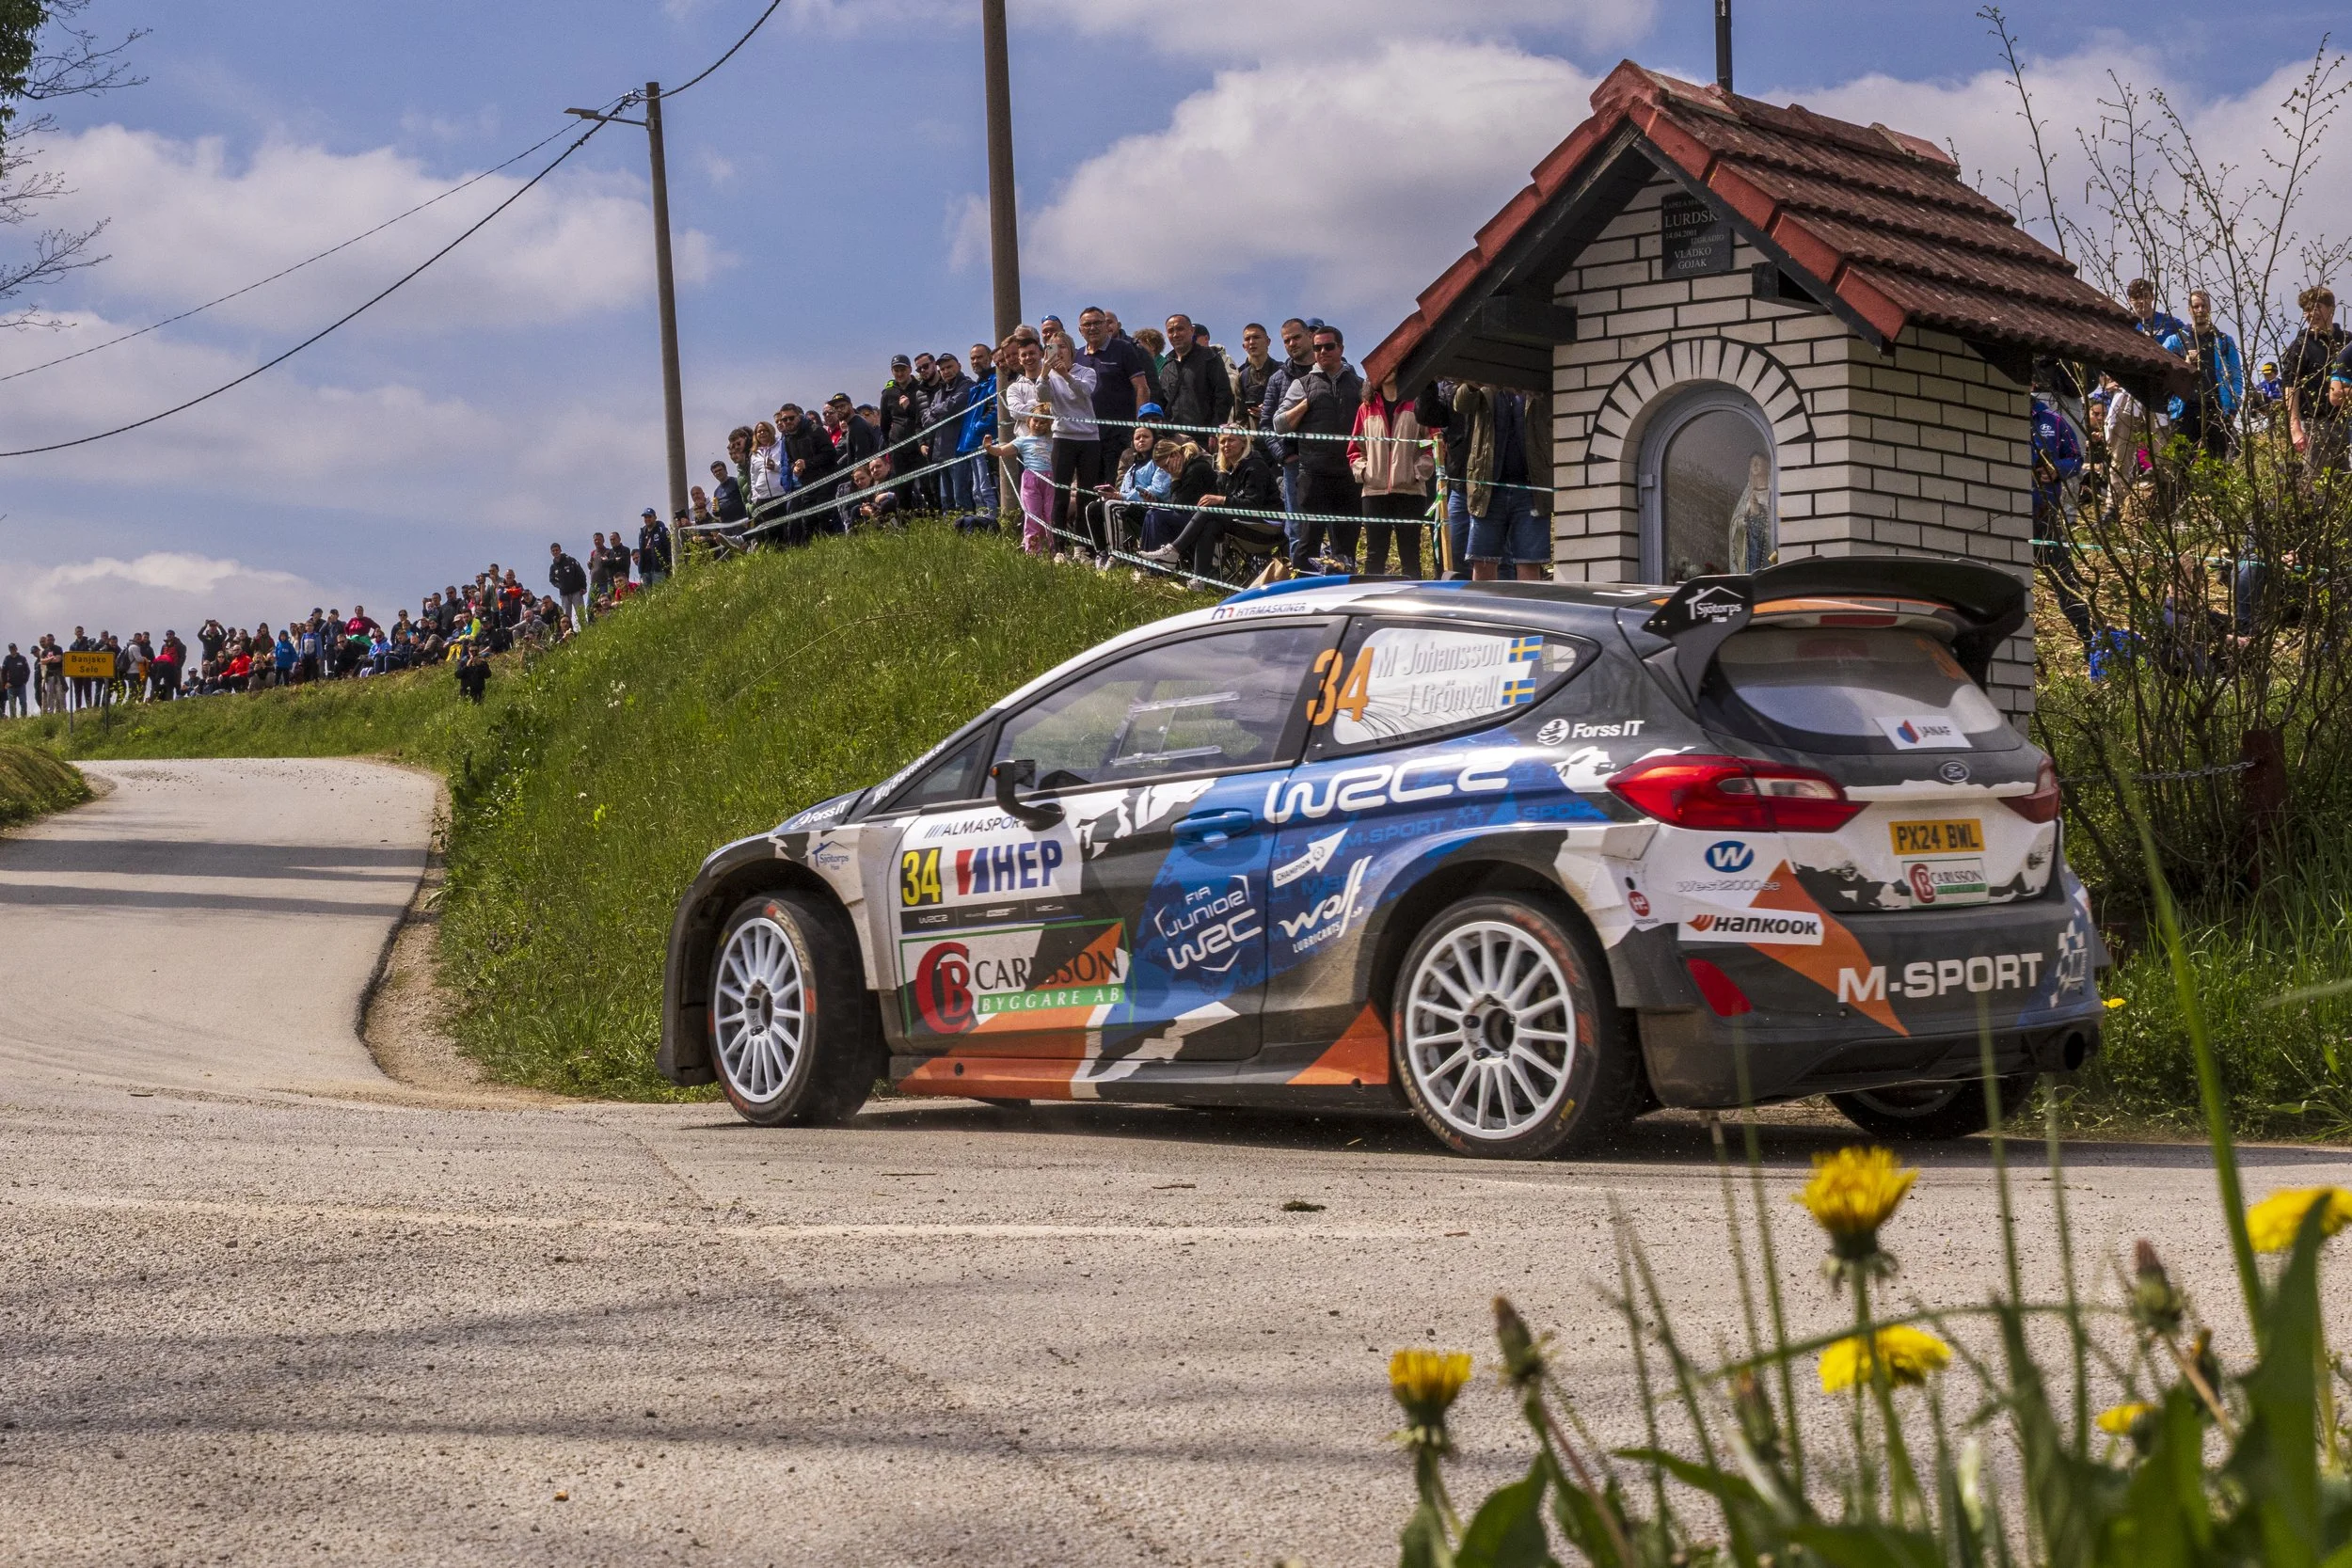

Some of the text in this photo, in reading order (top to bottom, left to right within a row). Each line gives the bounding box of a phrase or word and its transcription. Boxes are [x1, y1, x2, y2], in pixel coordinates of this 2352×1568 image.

[1664, 210, 1722, 228] LURDSK
[1675, 246, 1711, 259] VLADKO
[1677, 259, 1707, 270] GOJAK
[1306, 641, 1506, 726] 34 M Johansson
[1400, 675, 1502, 717] J Grönvall
[1571, 721, 1645, 739] Forss IT
[941, 816, 1027, 838] ALMASPOR
[1897, 825, 1942, 851] PX24
[902, 840, 1063, 906] 34 HEP
[1931, 869, 1983, 886] CARLSSON
[1185, 886, 1211, 905] FIA
[1167, 890, 1246, 937] JUNIOR
[1167, 908, 1263, 970] WRC
[975, 949, 1121, 991] CARSON
[1837, 953, 2043, 1004] M-SPORT
[982, 988, 1120, 1012] BYGGARE AB
